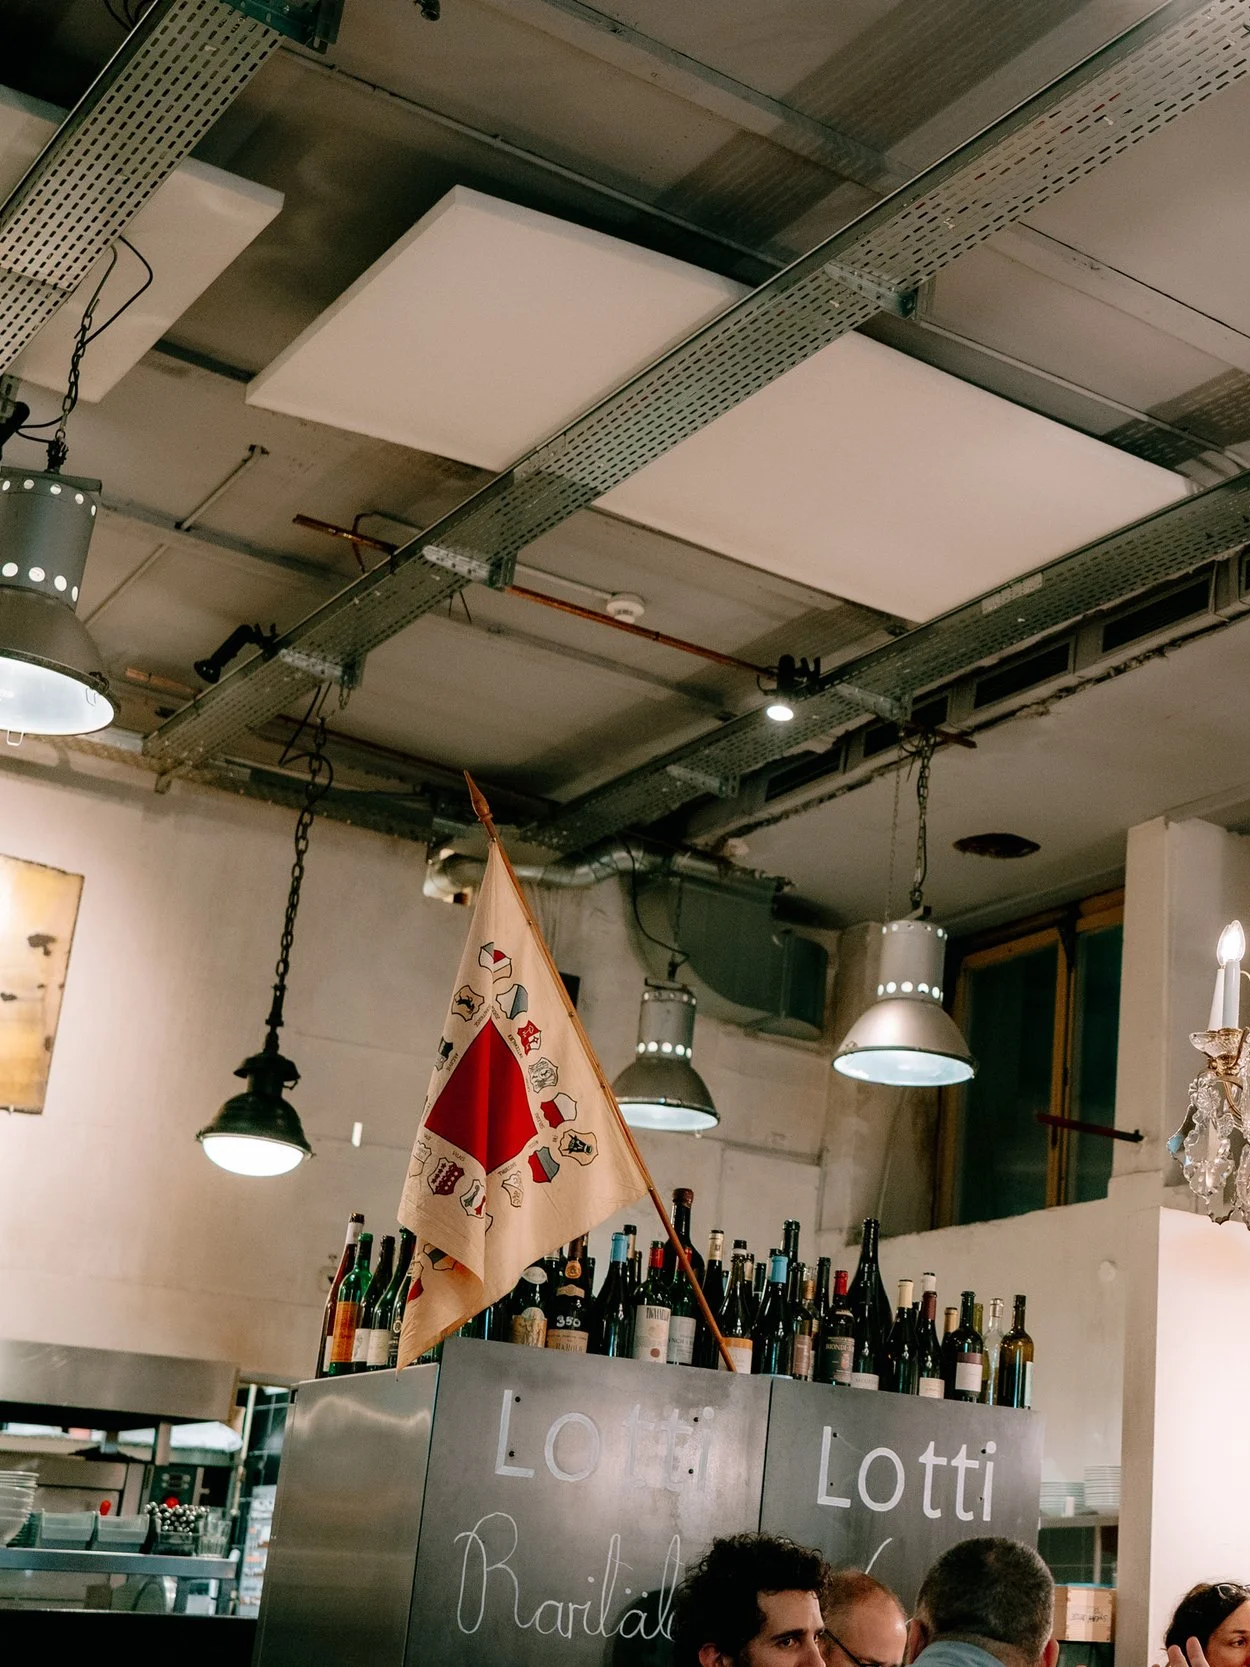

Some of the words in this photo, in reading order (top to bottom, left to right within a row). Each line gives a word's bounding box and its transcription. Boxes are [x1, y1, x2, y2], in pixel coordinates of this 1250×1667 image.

[555, 1314, 582, 1328] 350
[495, 1389, 715, 1493] Lotti
[817, 1425, 998, 1522] Lotti
[452, 1511, 686, 1643] Rarität
